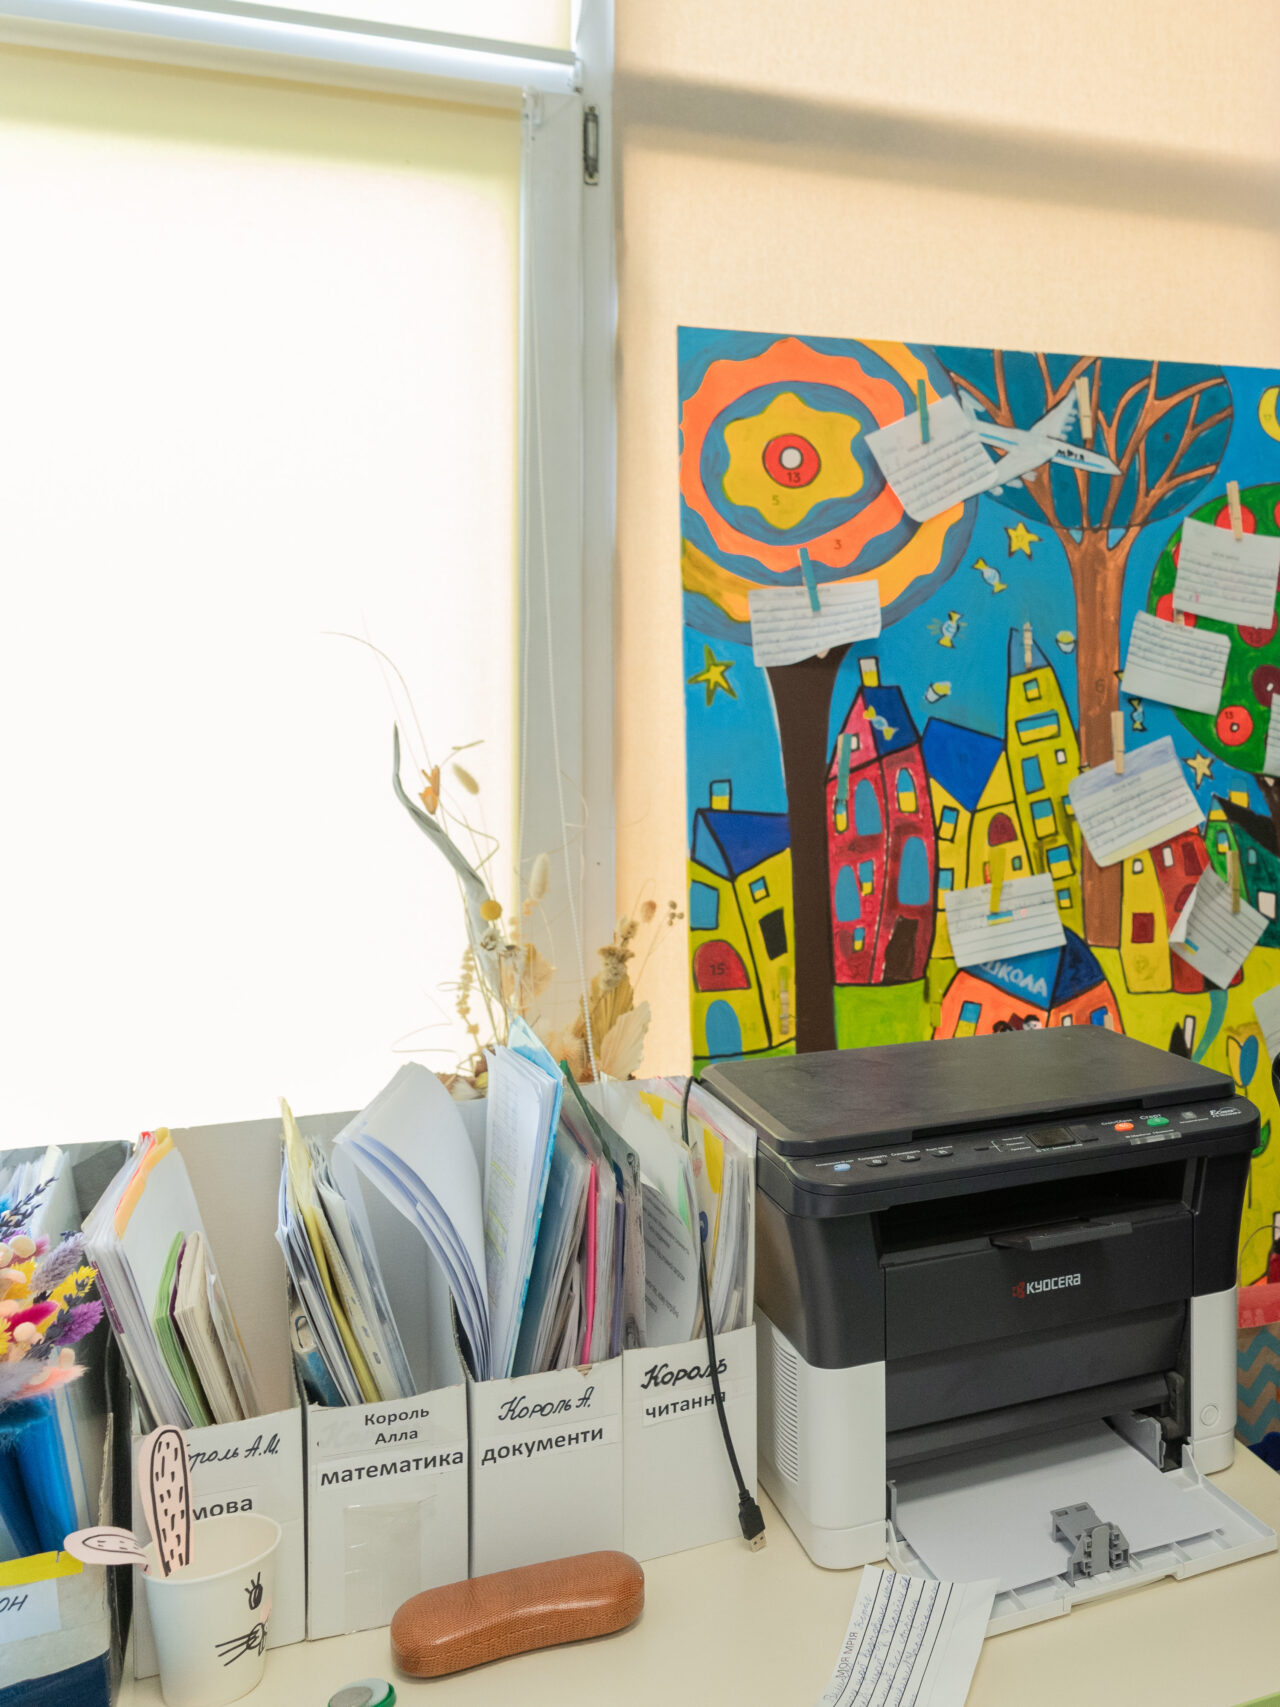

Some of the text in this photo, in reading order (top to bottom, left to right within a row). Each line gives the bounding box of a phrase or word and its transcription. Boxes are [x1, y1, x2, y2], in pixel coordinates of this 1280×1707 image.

[786, 471, 801, 484] 13
[771, 494, 781, 506] 5
[833, 538, 842, 550] 3
[709, 963, 726, 976] 15
[1026, 1273, 1081, 1295] KYOCERA
[498, 1386, 595, 1421] Король А.
[364, 1408, 430, 1426] Король
[374, 1429, 418, 1445] Алла
[481, 1427, 603, 1466] документи
[186, 1443, 239, 1473] роль
[320, 1451, 464, 1486] математика
[835, 1657, 851, 1679] МОЯ
[843, 1631, 859, 1655] МРІЯ
